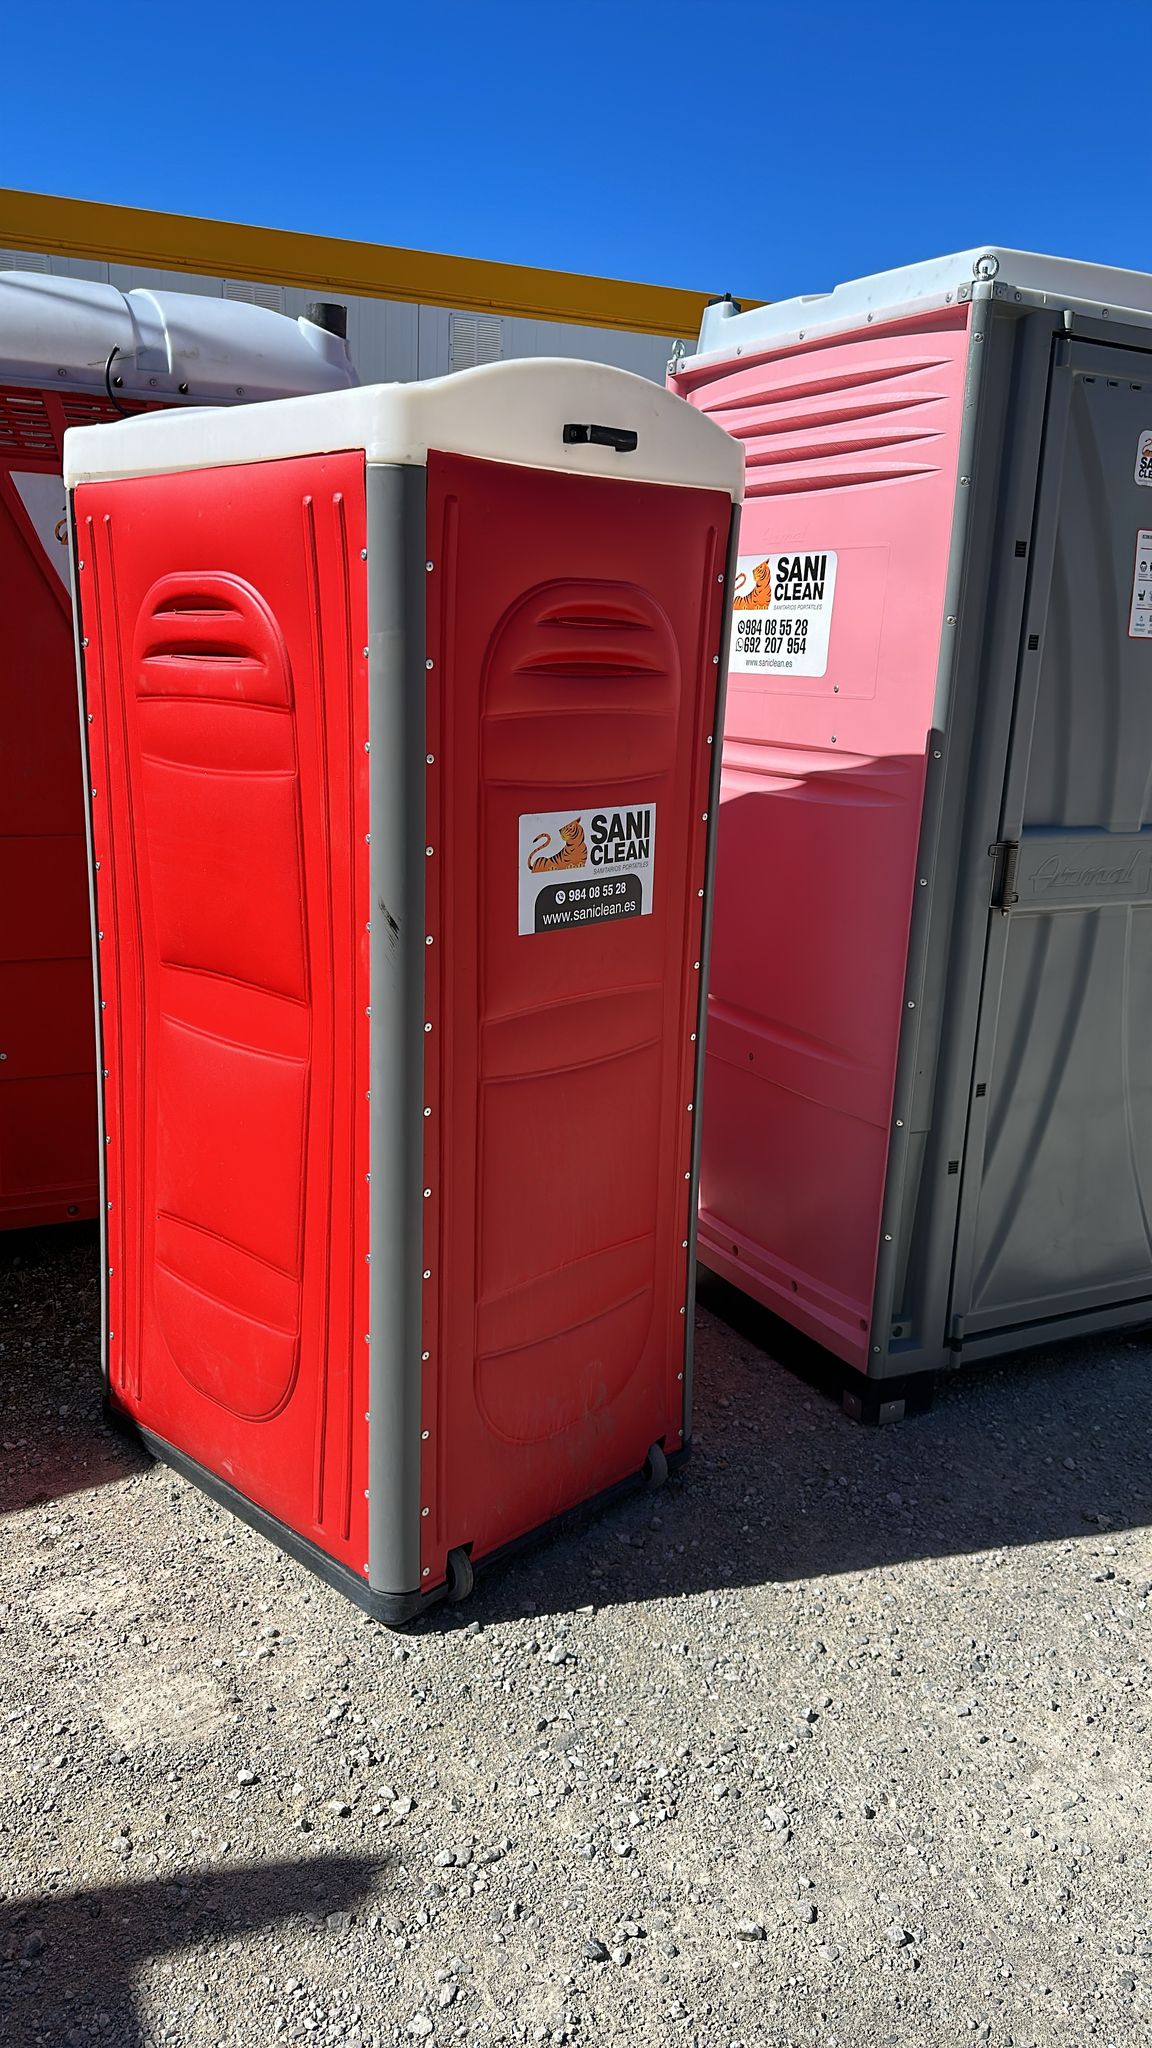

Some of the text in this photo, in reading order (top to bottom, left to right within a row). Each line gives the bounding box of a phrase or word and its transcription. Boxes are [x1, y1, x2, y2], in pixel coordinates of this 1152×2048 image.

[775, 555, 827, 582] SANI
[774, 582, 825, 601] CLEAN
[745, 618, 808, 636] 984 08 55 28
[744, 636, 806, 654] 692 207 954
[745, 659, 793, 668] www.saniclean.es
[590, 810, 650, 845] SANI
[590, 838, 650, 866] CLEAN
[1028, 848, 1144, 892] Armal
[568, 882, 626, 902] 984 08 55 28
[542, 900, 636, 925] www.saniclean.es
